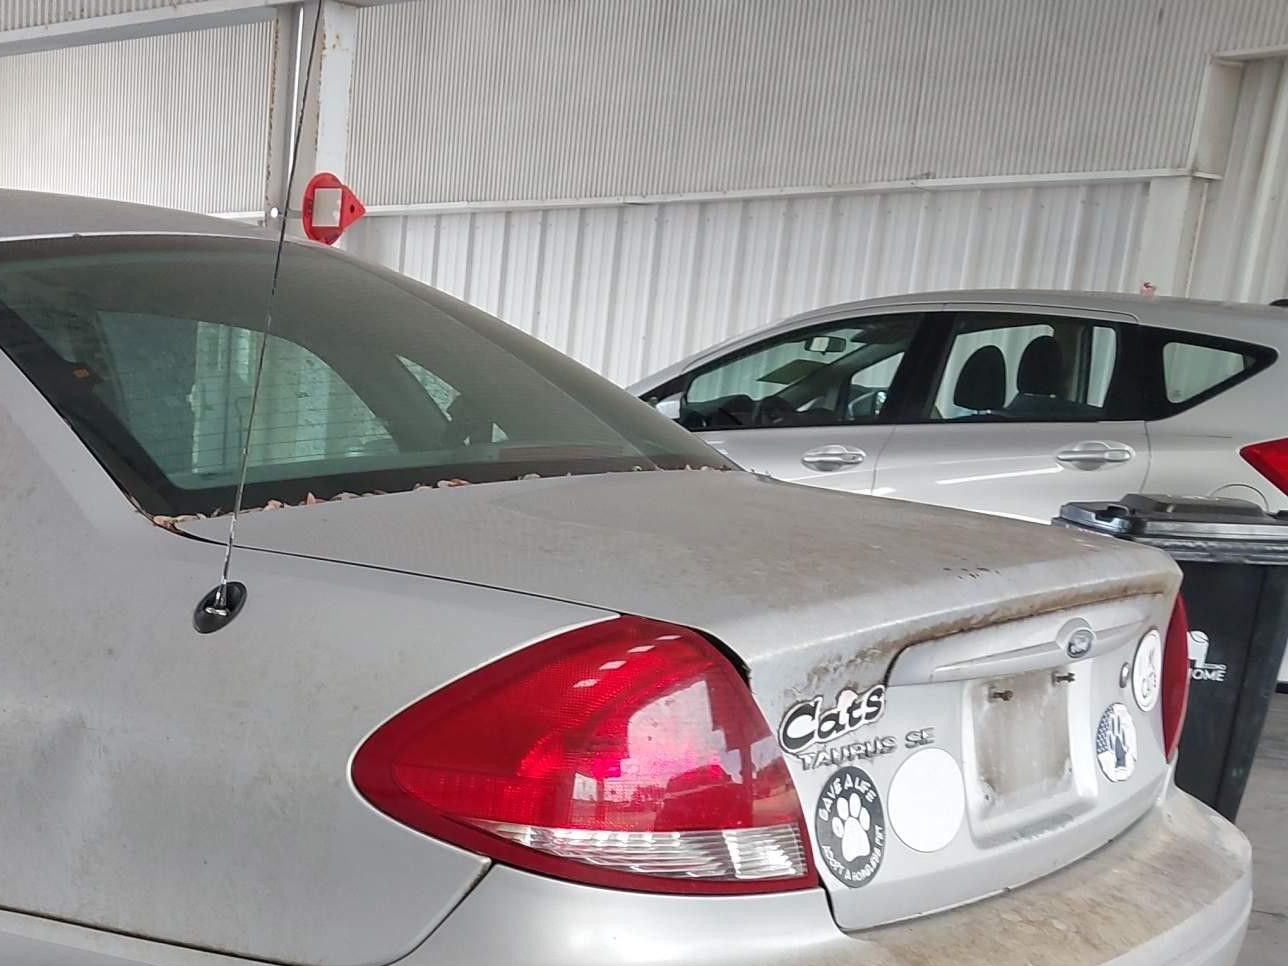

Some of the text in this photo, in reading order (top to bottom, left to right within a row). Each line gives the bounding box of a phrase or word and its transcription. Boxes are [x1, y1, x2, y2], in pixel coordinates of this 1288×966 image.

[781, 686, 885, 751] Cats
[799, 727, 935, 770] TAURUS SE
[844, 773, 854, 790] A
